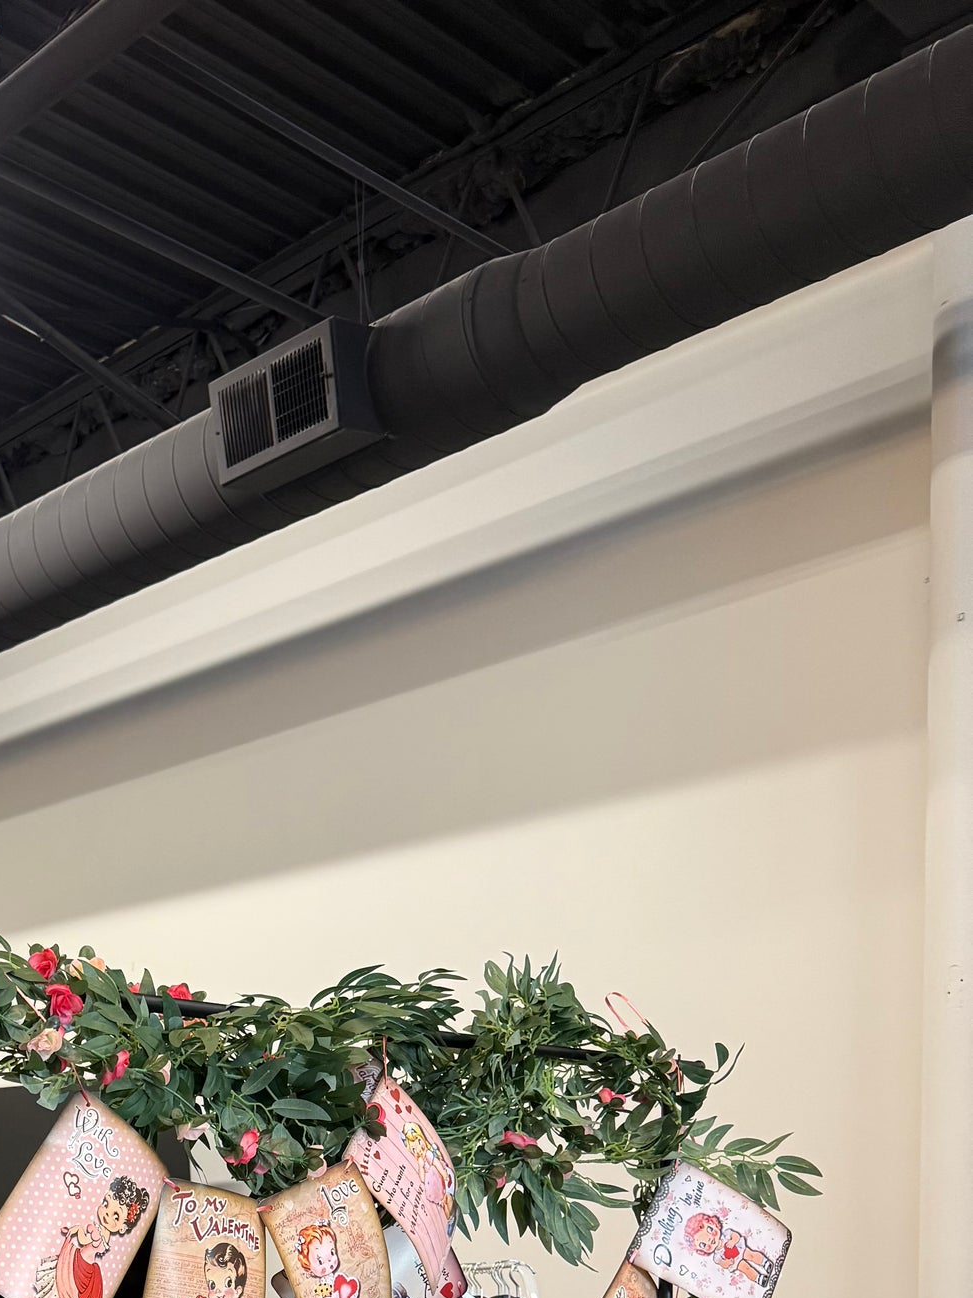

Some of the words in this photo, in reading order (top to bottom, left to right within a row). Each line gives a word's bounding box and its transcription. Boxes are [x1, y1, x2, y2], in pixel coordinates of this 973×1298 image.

[68, 1105, 119, 1158] With
[72, 1141, 112, 1178] Love
[371, 1168, 389, 1193] Guess
[386, 1187, 397, 1205] who
[394, 1164, 407, 1187] wants
[399, 1187, 411, 1201] for
[409, 1180, 415, 1188] a
[693, 1179, 705, 1209] mine
[172, 1191, 197, 1226] TO
[201, 1196, 227, 1214] MY
[320, 1178, 360, 1226] LOVE
[397, 1201, 407, 1219] you
[190, 1216, 260, 1251] VALENTINE
[653, 1205, 683, 1268] Darling,
[679, 1190, 693, 1208] be
